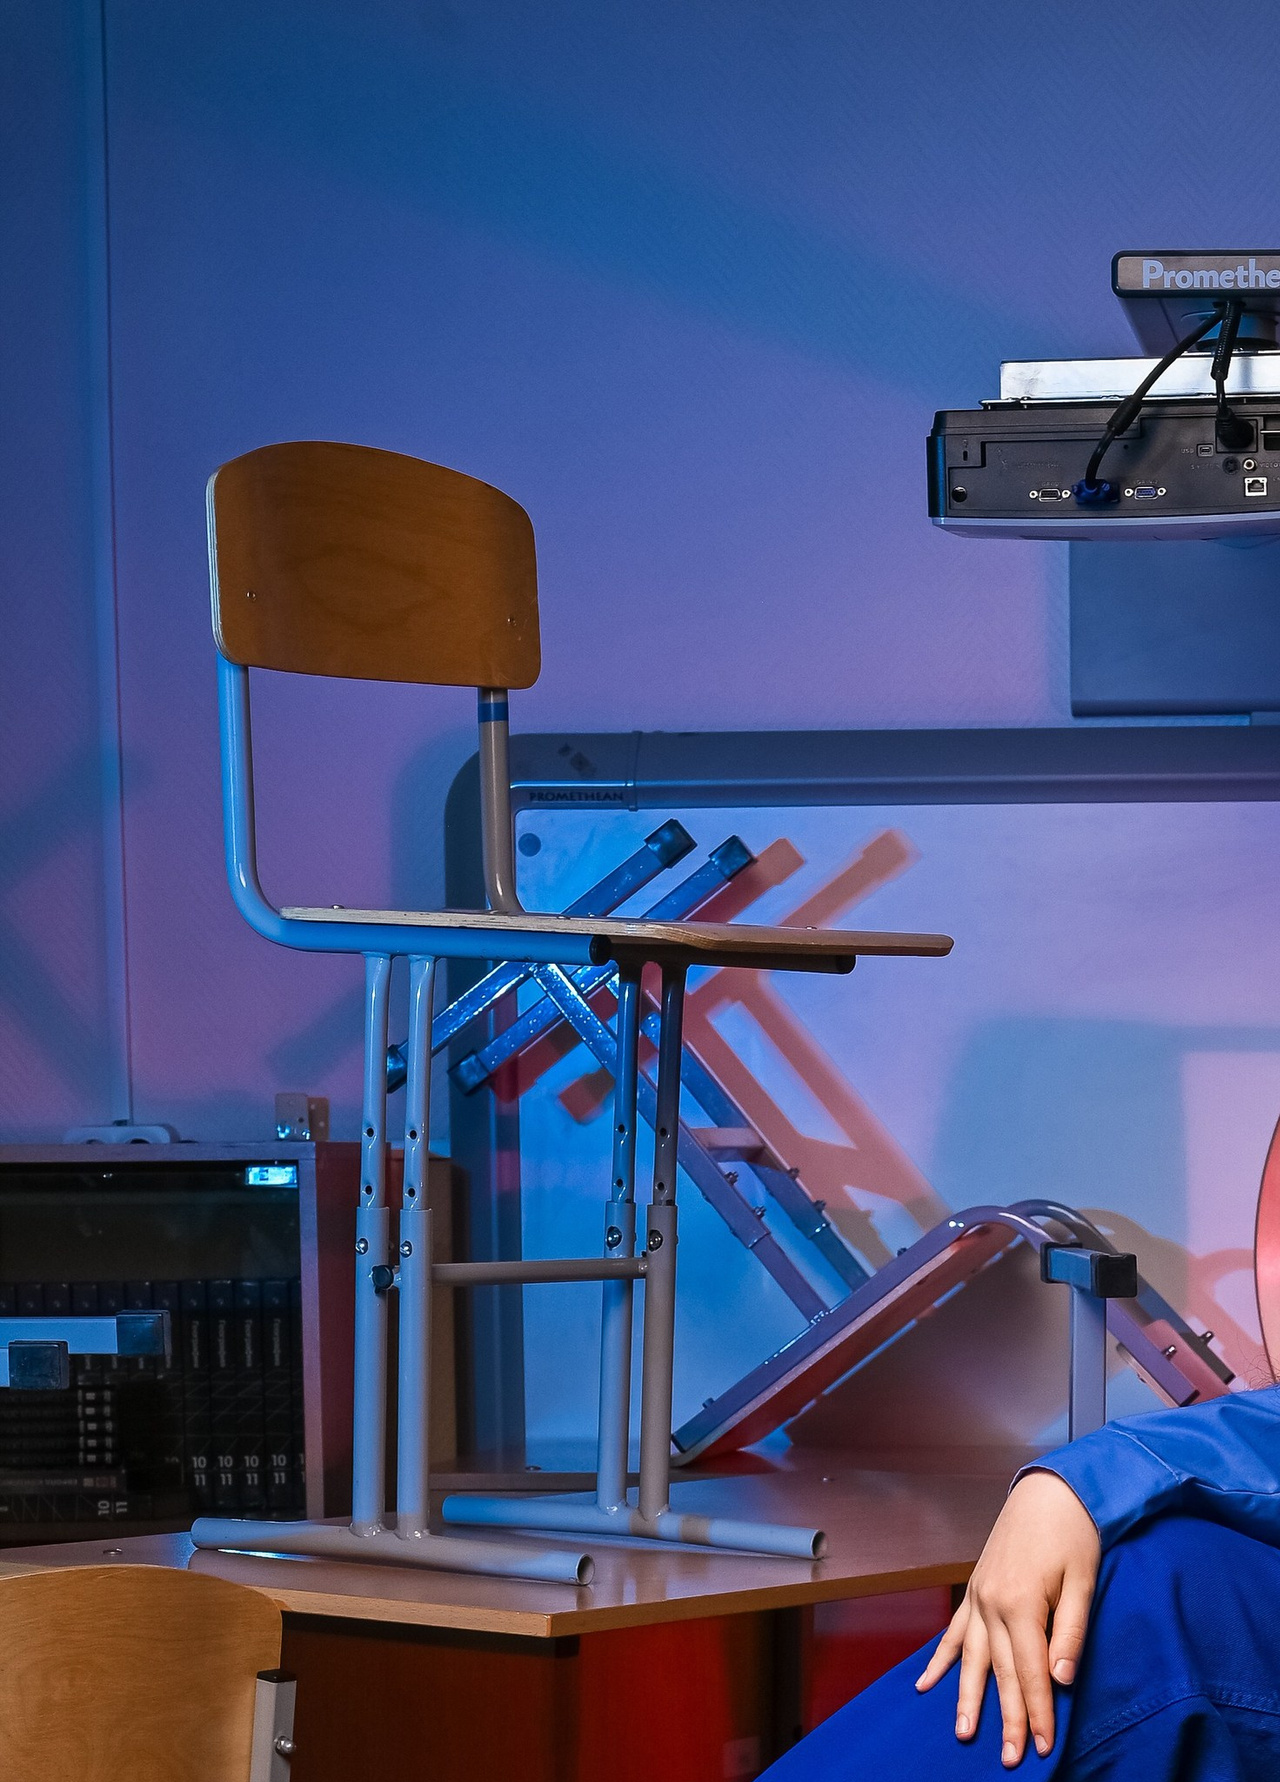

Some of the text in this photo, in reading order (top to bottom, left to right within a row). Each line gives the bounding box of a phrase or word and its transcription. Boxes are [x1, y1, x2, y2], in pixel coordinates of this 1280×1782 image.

[529, 791, 624, 802] PROMETHEAN
[192, 1456, 207, 1469] 10
[218, 1455, 233, 1468] 10
[244, 1455, 259, 1468] 10
[271, 1454, 287, 1467] 10
[194, 1473, 206, 1486] 11
[220, 1473, 232, 1486] 11
[245, 1473, 258, 1486] 11
[273, 1472, 286, 1485] 11
[97, 1500, 110, 1516] 10
